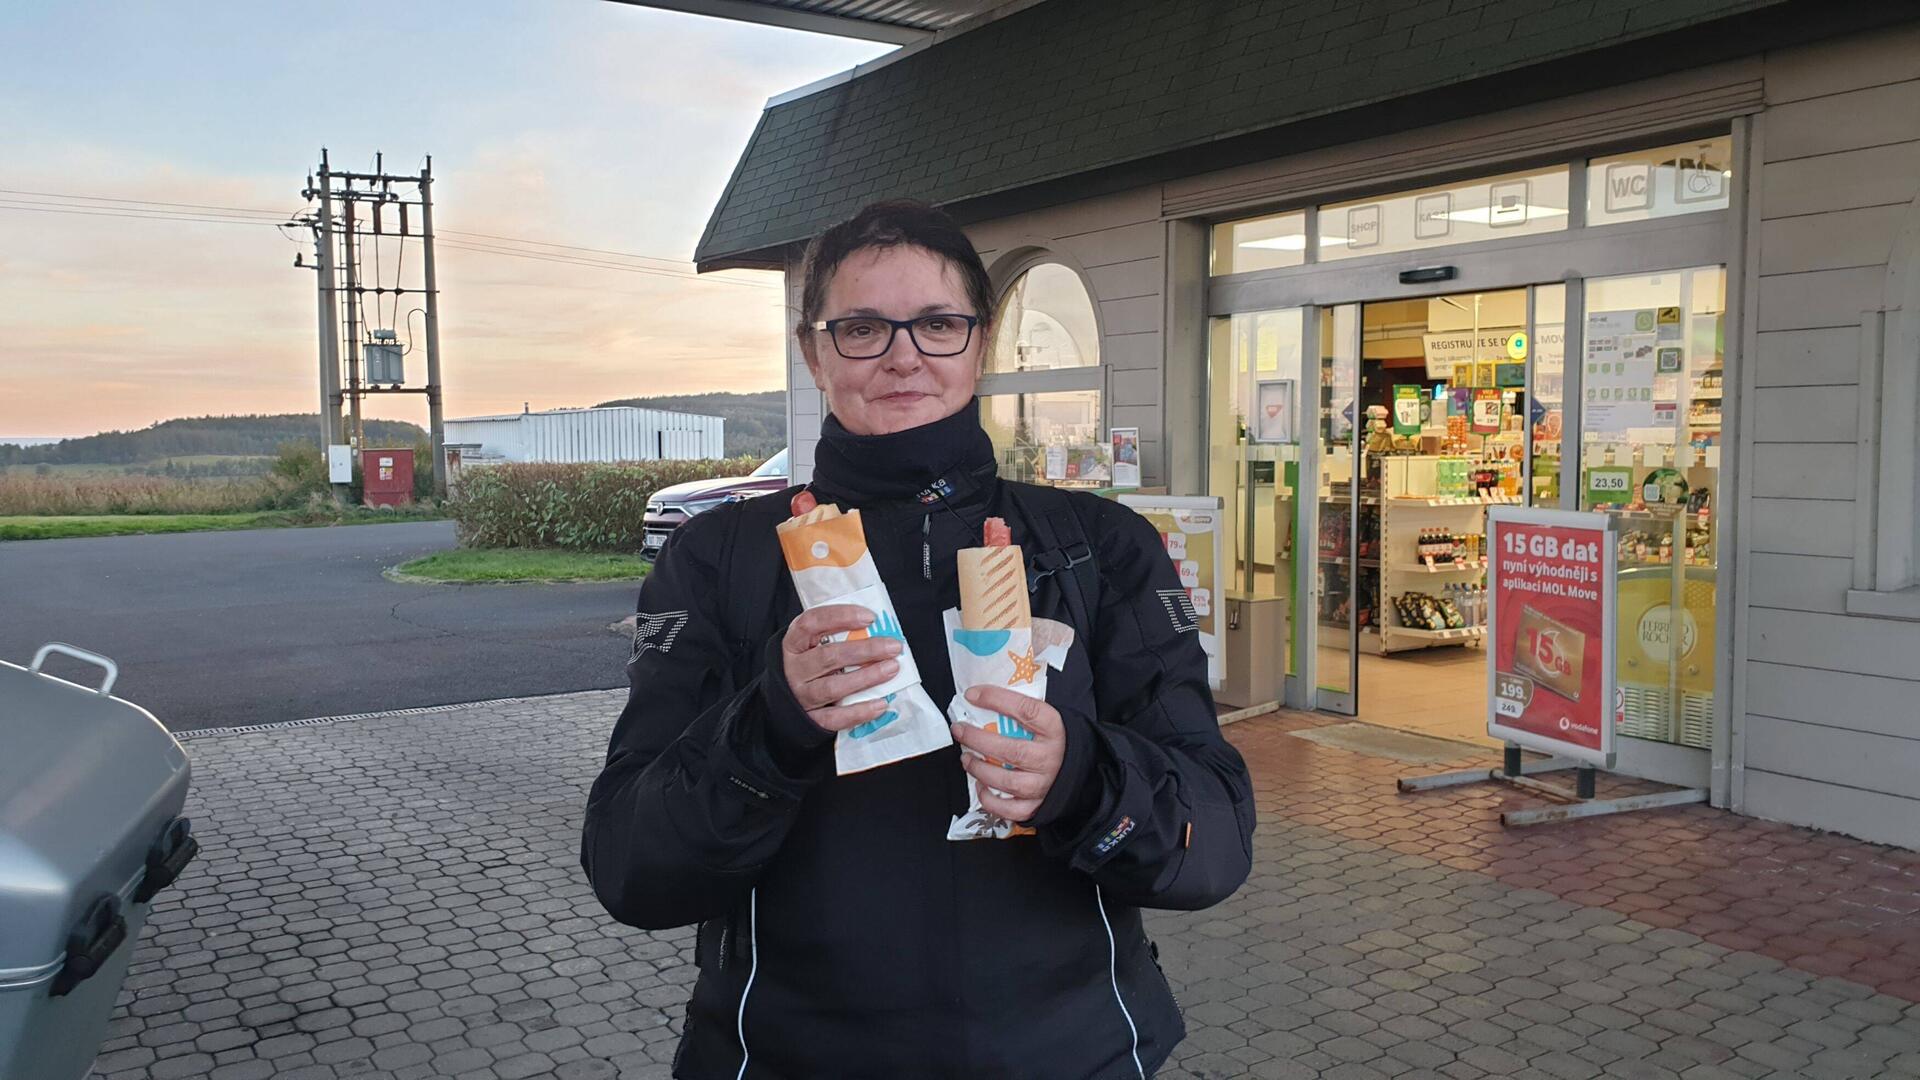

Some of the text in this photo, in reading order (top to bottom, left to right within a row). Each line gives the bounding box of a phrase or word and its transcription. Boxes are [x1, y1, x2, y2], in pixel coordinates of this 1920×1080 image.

[1611, 174, 1645, 198] WC
[1350, 221, 1377, 235] SHOP
[1431, 338, 1487, 350] REGISTRUTE
[1488, 336, 1499, 347] SE
[1594, 478, 1624, 489] 23,50
[1168, 540, 1178, 549] 79
[1503, 532, 1599, 563] 15 GB dat
[1503, 559, 1598, 583] nyní výhodněji s
[1503, 578, 1598, 600] aplikací MOL Move
[1643, 619, 1689, 634] FERREO
[1527, 626, 1553, 664] 15
[1642, 631, 1689, 646] ROCR
[1555, 656, 1572, 676] GB
[1501, 682, 1524, 699] 199
[1570, 722, 1599, 735] vodafone
